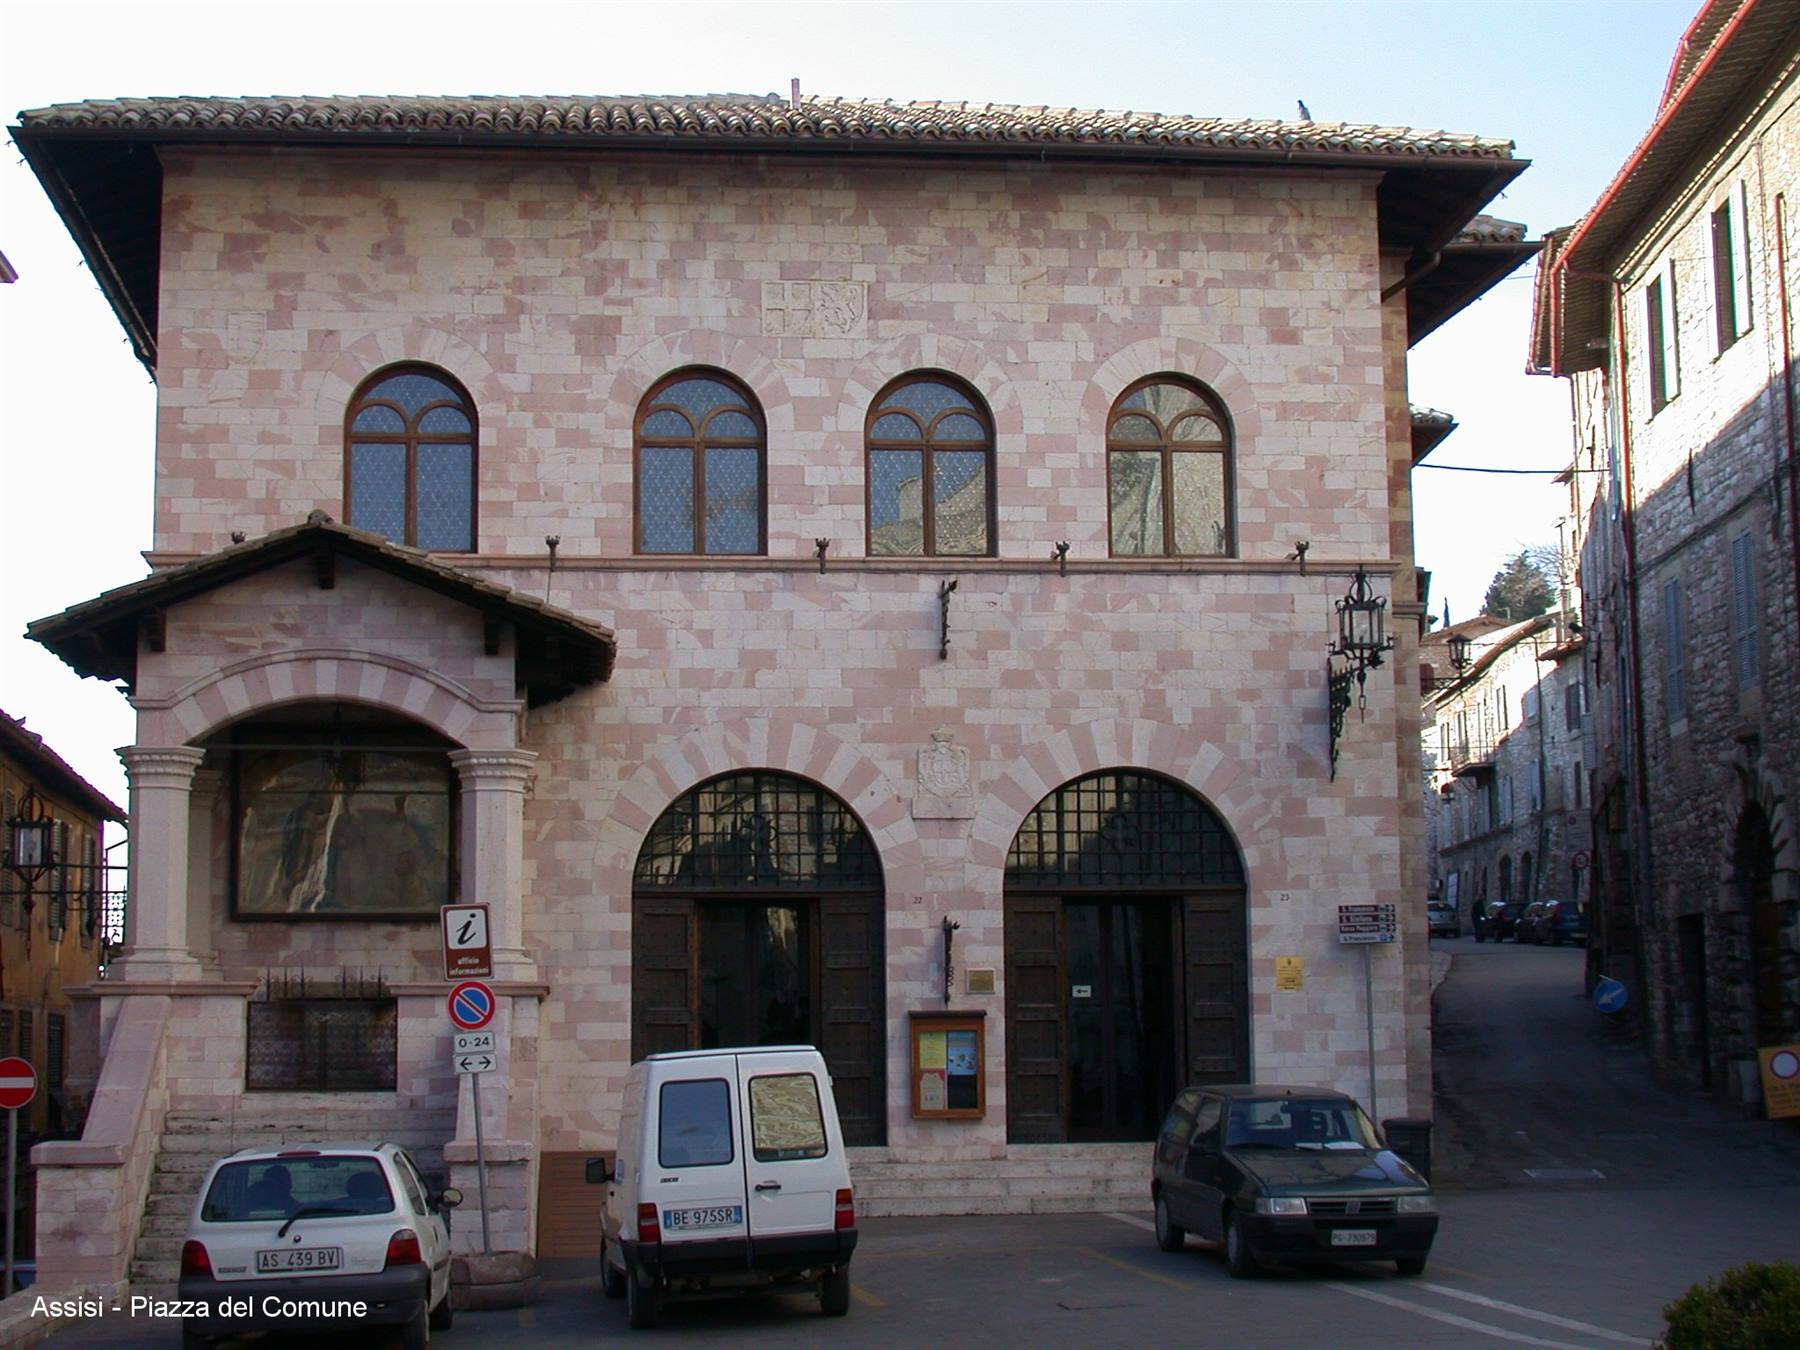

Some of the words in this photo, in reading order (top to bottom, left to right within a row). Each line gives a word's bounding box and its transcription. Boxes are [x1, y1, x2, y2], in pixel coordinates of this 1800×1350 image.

[1280, 893, 1290, 902] 23
[456, 913, 477, 945] i
[457, 956, 480, 965] ufficio
[449, 967, 489, 976] informazioni
[673, 1211, 688, 1225] BE
[693, 1208, 733, 1224] 975SR
[262, 1253, 279, 1268] AS
[288, 1251, 313, 1267] 439
[318, 1250, 335, 1265] BV
